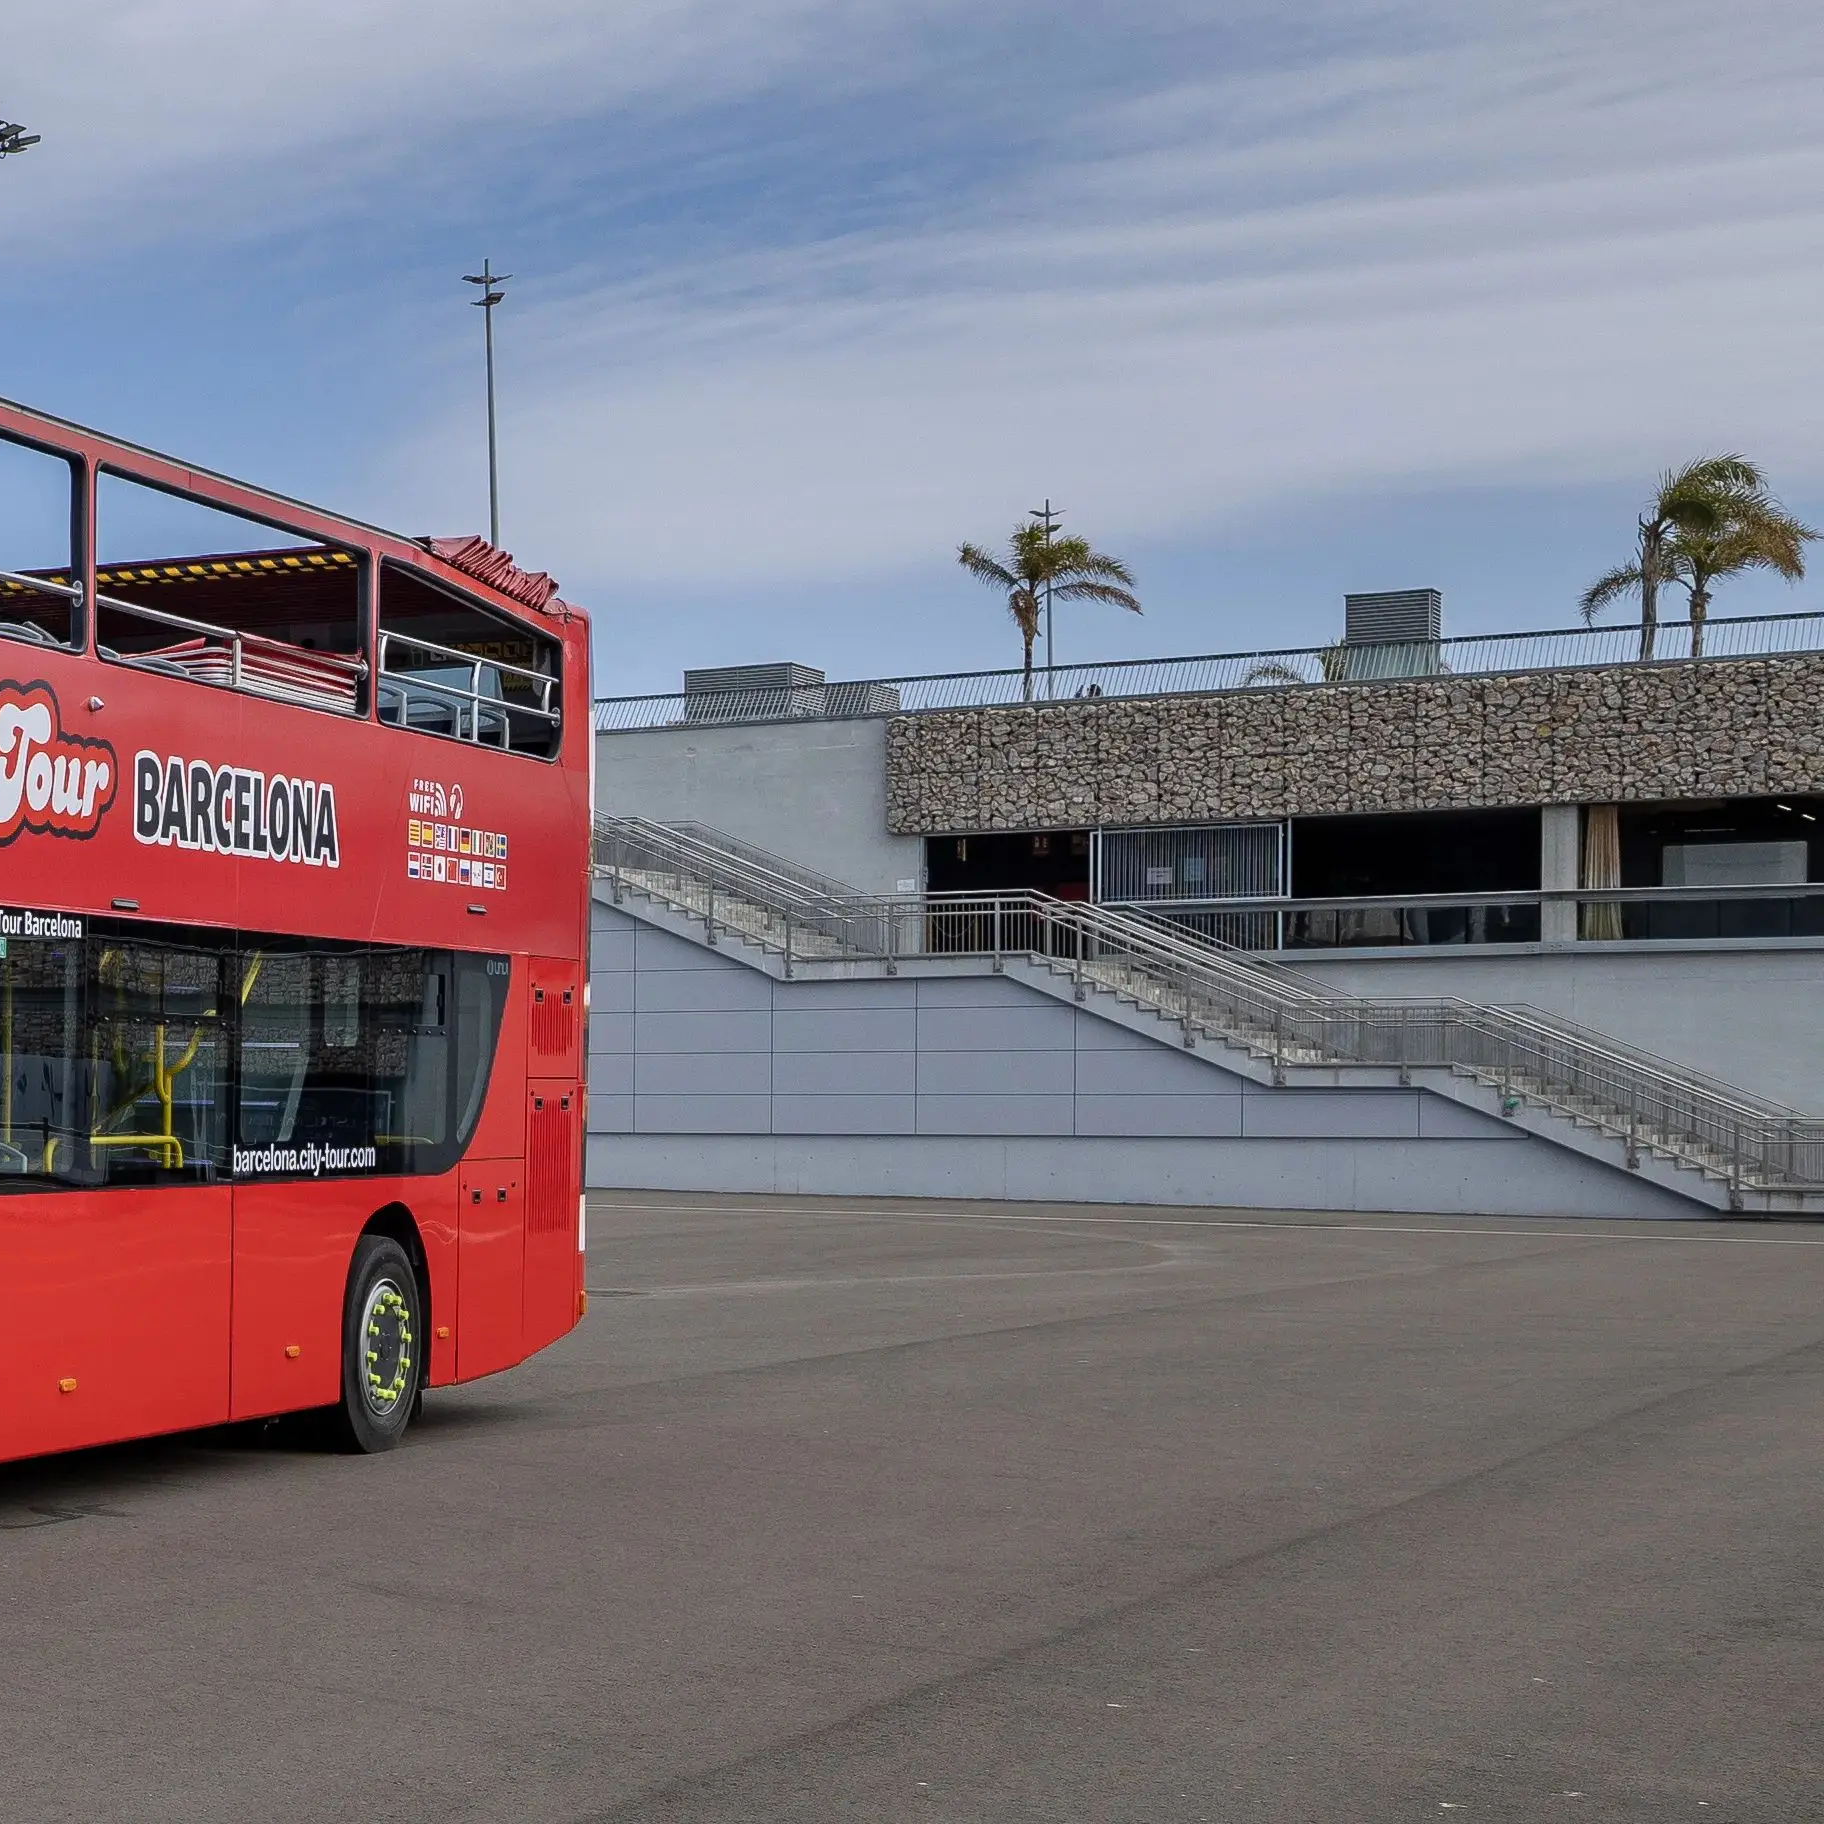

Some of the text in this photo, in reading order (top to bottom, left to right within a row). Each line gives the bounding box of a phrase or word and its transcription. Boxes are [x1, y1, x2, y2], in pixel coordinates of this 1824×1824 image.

[414, 778, 435, 793] FREE
[134, 749, 340, 868] BARCELONA
[24, 911, 82, 938] Barcelona
[233, 1142, 376, 1177] barcelona.city-tour.com
